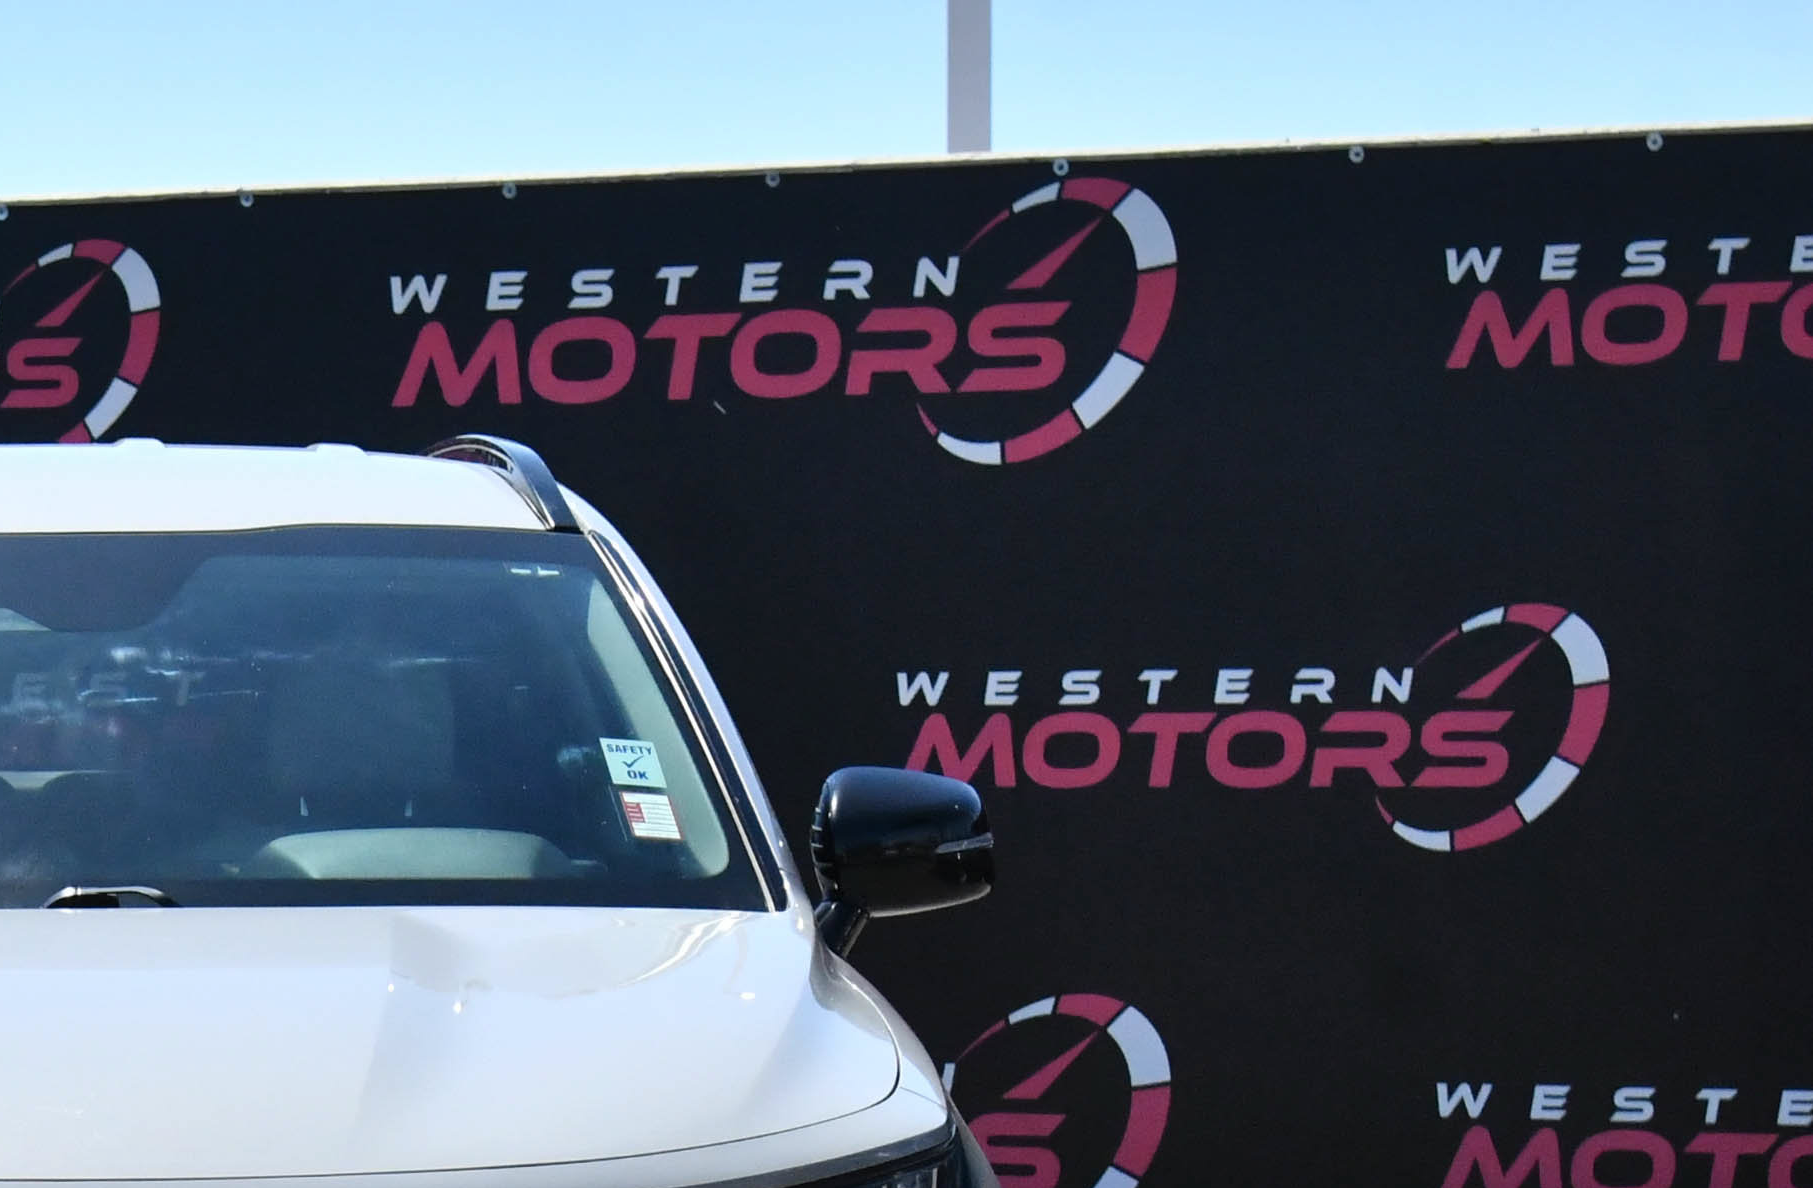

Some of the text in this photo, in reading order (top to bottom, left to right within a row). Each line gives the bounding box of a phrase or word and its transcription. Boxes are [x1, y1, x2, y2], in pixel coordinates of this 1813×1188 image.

[390, 255, 961, 314] WESTERN
[392, 300, 1072, 407] MOTORS
[897, 667, 1413, 706] WESTERN
[606, 743, 652, 755] SAFETY
[905, 710, 1515, 788] MOTORS
[627, 769, 648, 780] OK
[1436, 1082, 1813, 1126] WESTE
